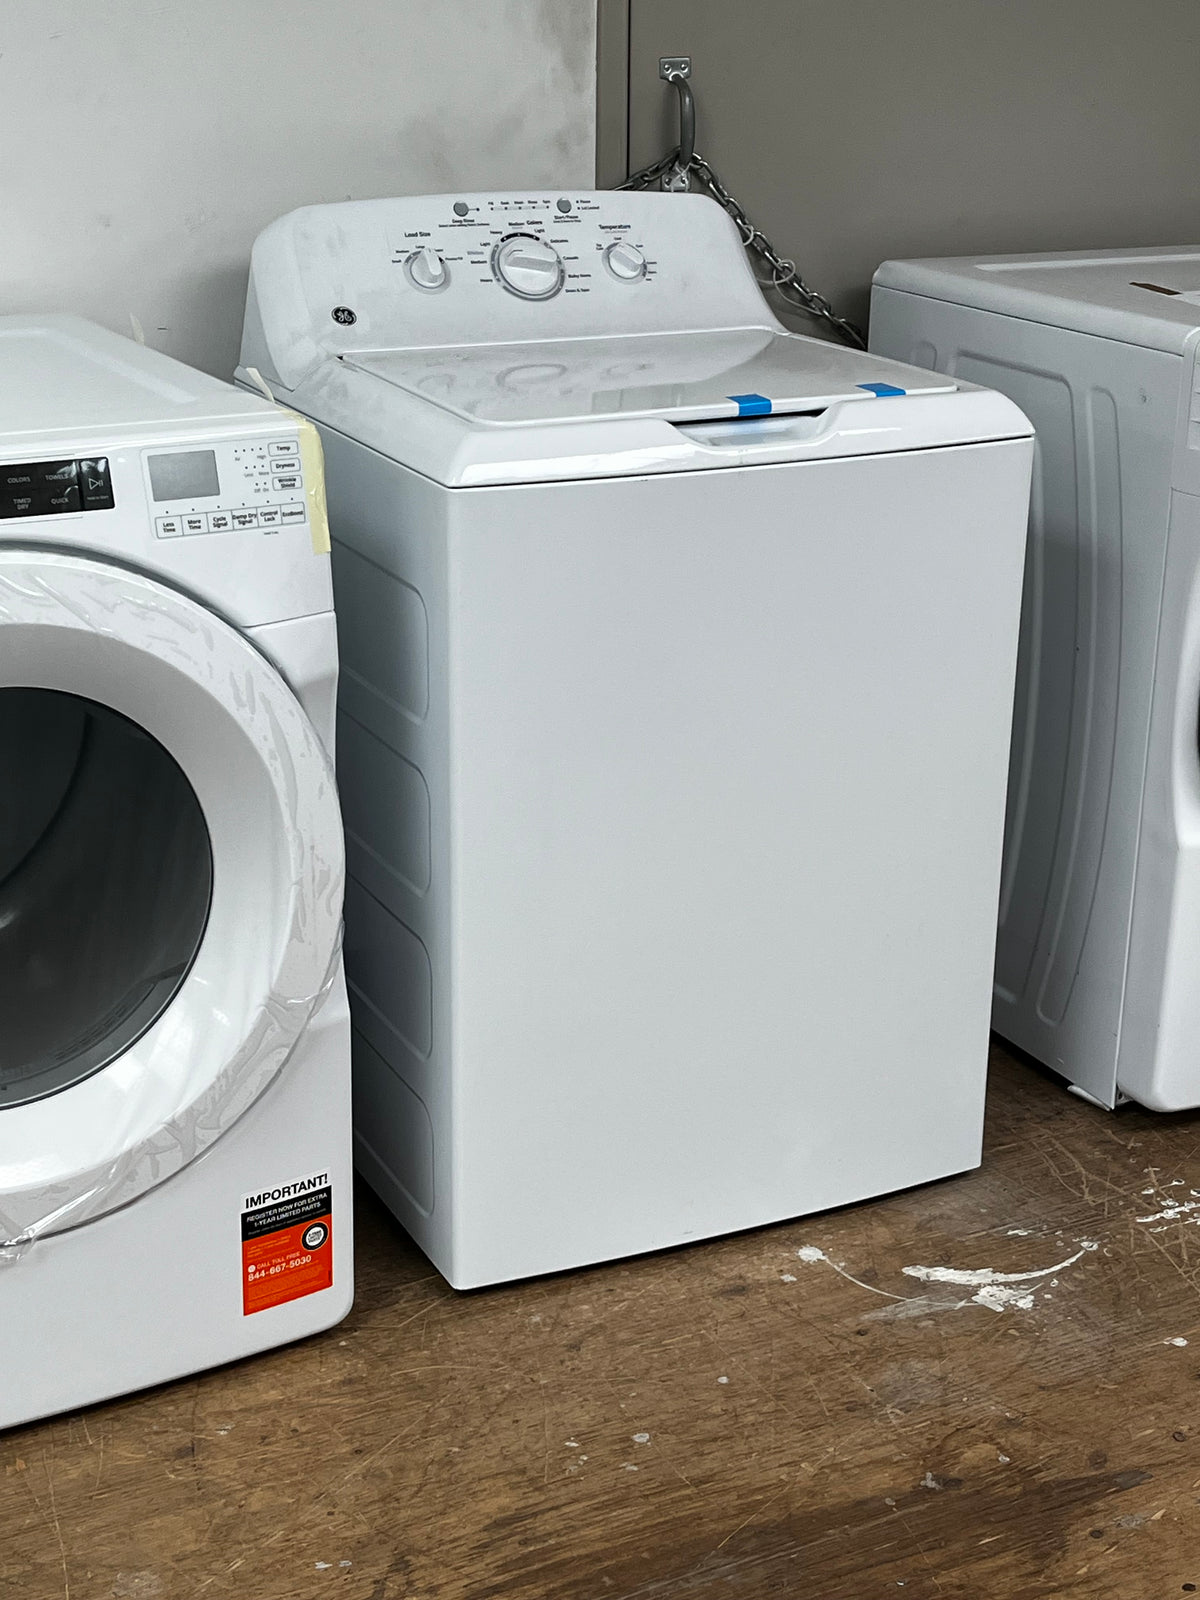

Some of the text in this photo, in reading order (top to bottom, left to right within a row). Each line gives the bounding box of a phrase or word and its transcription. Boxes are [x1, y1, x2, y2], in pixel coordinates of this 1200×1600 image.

[7, 476, 31, 484] COLORS
[212, 516, 227, 524] Cycle
[212, 521, 228, 529] Signal
[247, 512, 257, 520] Dry
[245, 1173, 328, 1209] IMPORTANT!
[246, 1192, 328, 1222] REGISTER NOW FOR EXTRA
[254, 1215, 276, 1228] 1-YEAR
[276, 1208, 301, 1220] LIMITED
[301, 1202, 321, 1213] PARTS
[247, 1254, 313, 1282] 844-667-5030
[256, 1261, 270, 1270] CALL
[286, 1251, 301, 1260] FREE
